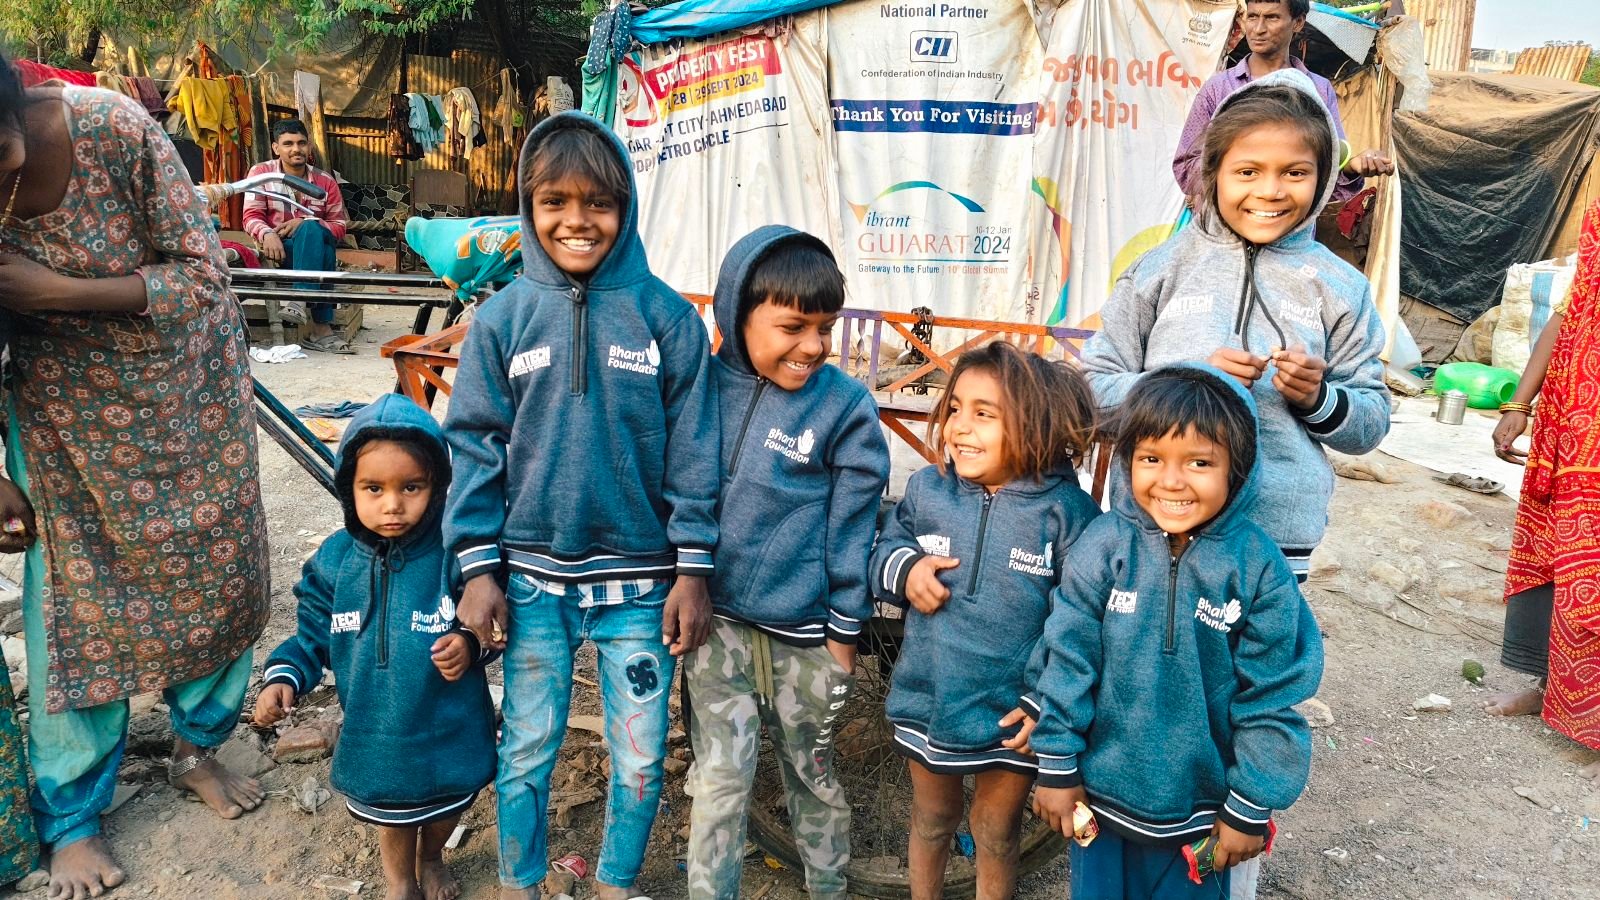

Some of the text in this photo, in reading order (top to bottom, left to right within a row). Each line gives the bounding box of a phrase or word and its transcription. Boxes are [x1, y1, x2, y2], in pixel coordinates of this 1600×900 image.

[880, 4, 988, 19] National Partner
[728, 40, 767, 67] FEST
[861, 69, 925, 79] Confederation
[927, 69, 936, 78] of
[967, 70, 1003, 82] Industry
[673, 92, 687, 106] 28
[733, 71, 759, 89] 2024
[832, 106, 1033, 128] Thank You For Visiting
[858, 232, 969, 256] GUJARAT
[973, 235, 1011, 255] 2024
[858, 264, 890, 275] Gateway
[893, 265, 900, 274] to
[903, 265, 915, 274] the
[917, 265, 940, 274] Future
[1280, 299, 1315, 318] Bharti
[609, 345, 645, 362] Bharti
[608, 357, 658, 376] Foundatio
[768, 428, 797, 448] Bharti
[764, 439, 810, 464] Foundation
[1010, 548, 1044, 566] Bharti
[1008, 560, 1054, 576] Foundation
[330, 611, 360, 628] TECH
[412, 610, 439, 624] Bharti
